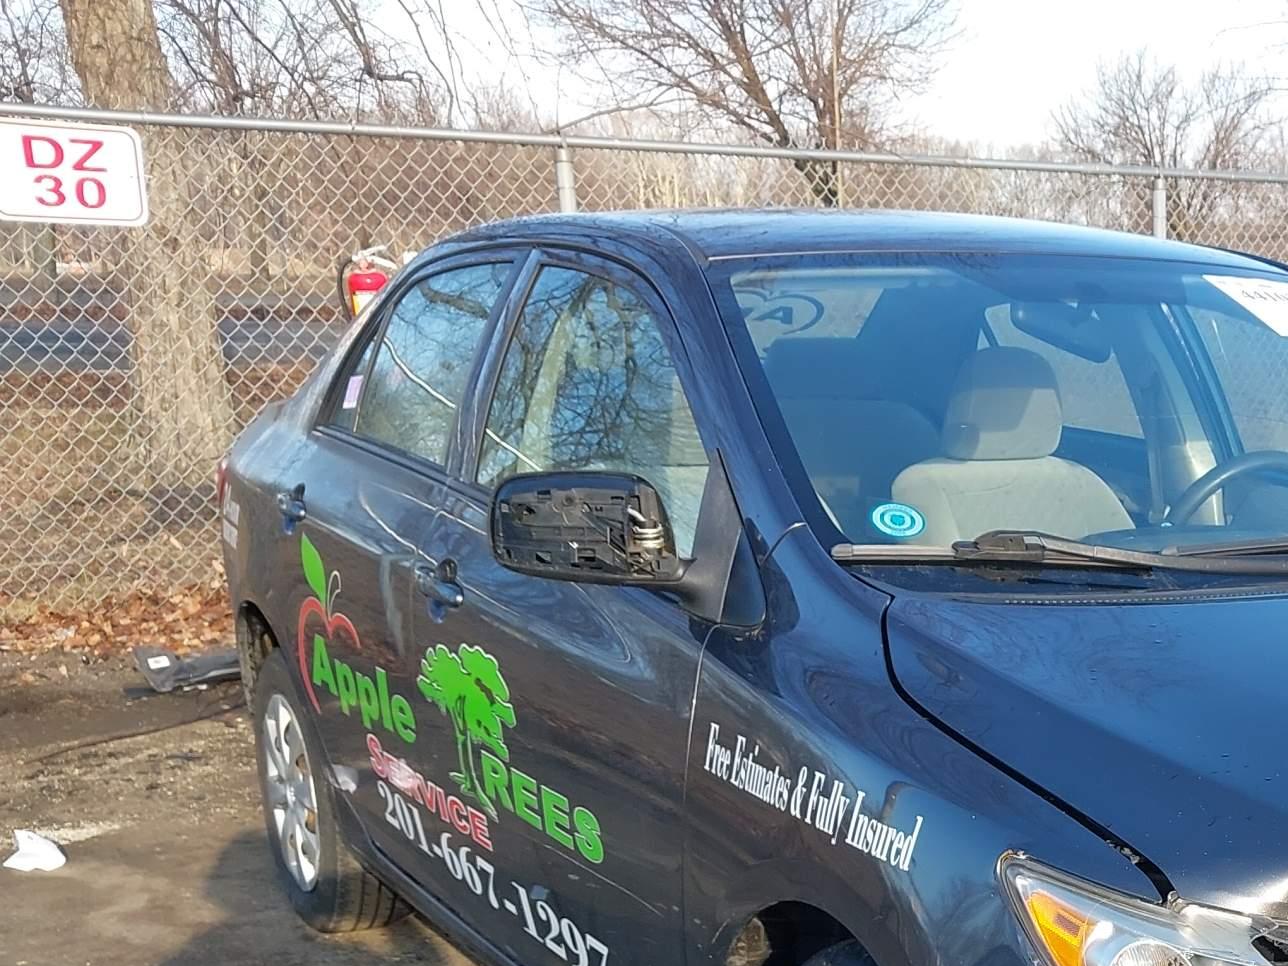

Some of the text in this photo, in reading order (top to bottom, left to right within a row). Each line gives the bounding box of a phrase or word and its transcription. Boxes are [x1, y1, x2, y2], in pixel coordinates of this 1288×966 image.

[22, 135, 107, 171] DZ
[34, 175, 106, 208] 30
[313, 633, 416, 743] Apple
[704, 722, 923, 871] Free Estimates & Fully Insured
